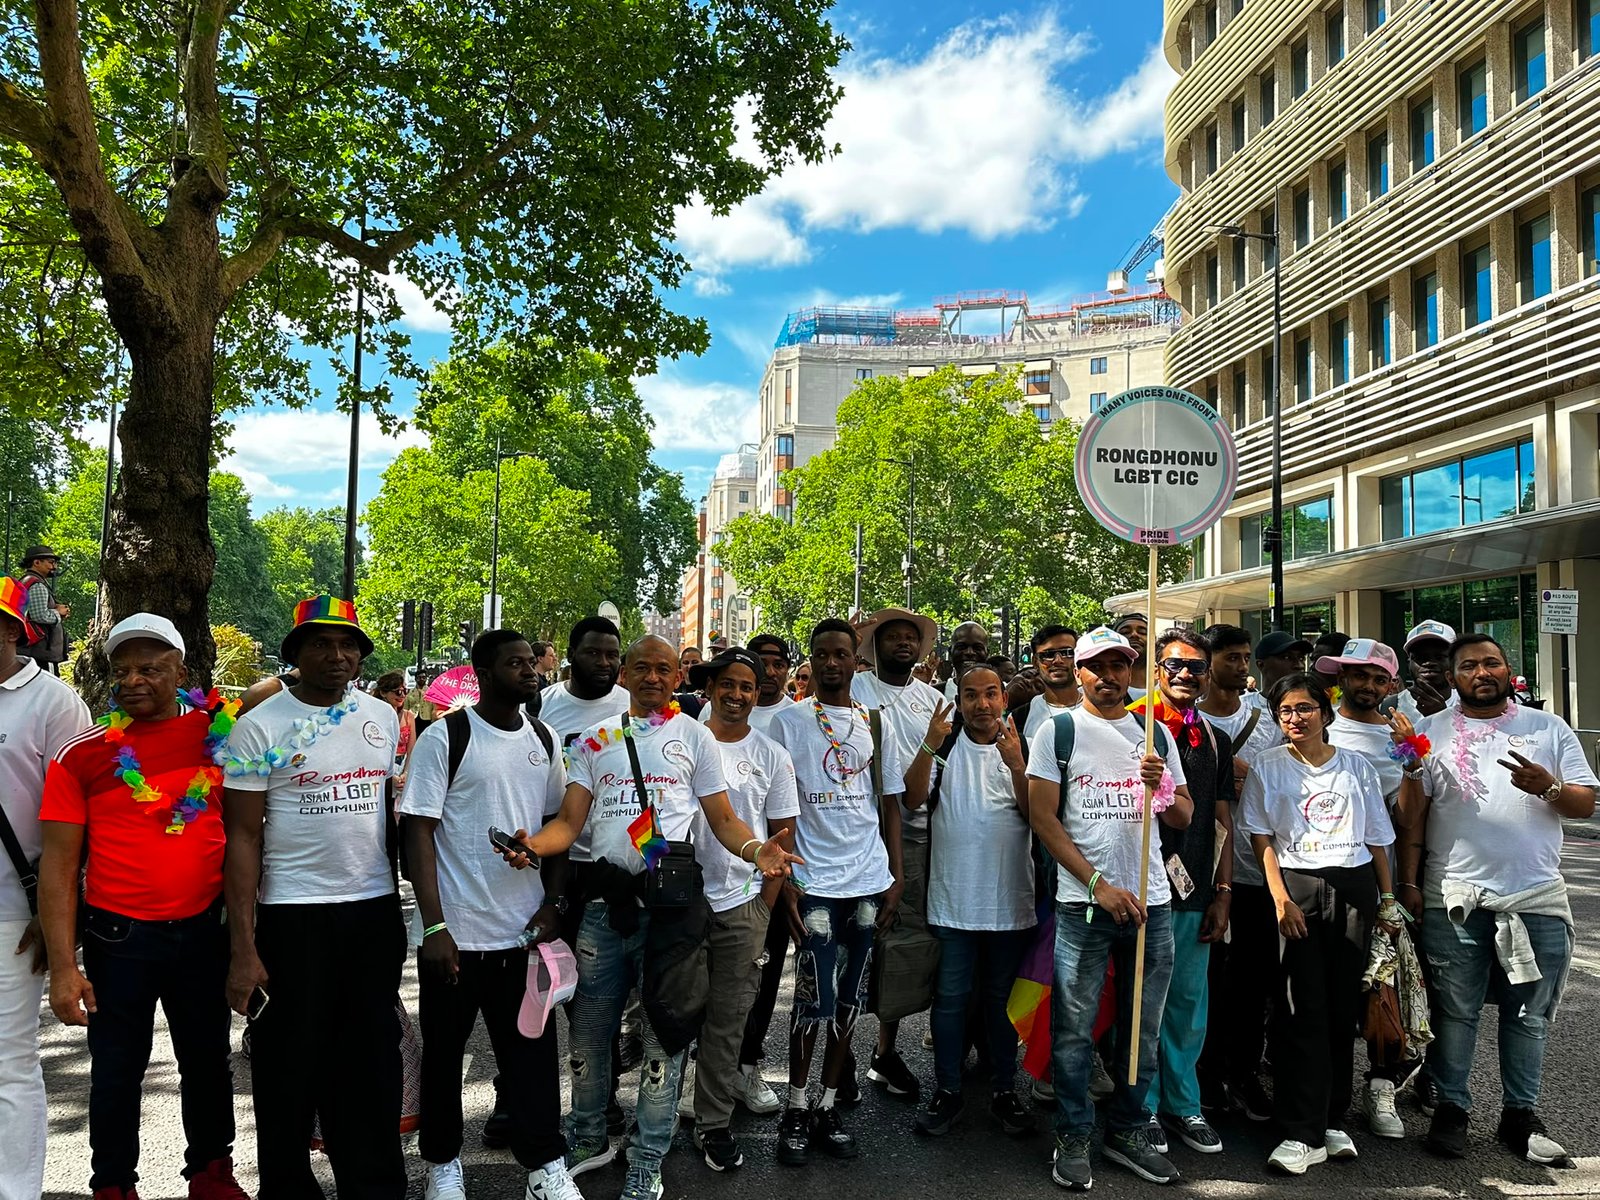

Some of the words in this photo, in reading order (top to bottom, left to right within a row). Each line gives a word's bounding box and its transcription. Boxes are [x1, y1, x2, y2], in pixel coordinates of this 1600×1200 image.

[1100, 395, 1126, 418] MANY
[1126, 388, 1164, 401] VOICES
[1165, 390, 1186, 402] ONE
[1186, 397, 1217, 421] FRONT
[1096, 447, 1218, 467] RONGDHONU
[1114, 468, 1162, 485] LGBT
[1166, 470, 1199, 486] CIC
[440, 676, 458, 688] THE
[460, 681, 480, 691] DRA
[462, 673, 479, 682] AM
[299, 791, 330, 804] ASIAN
[332, 782, 380, 801] LGBT
[803, 791, 835, 804] LGBT
[299, 801, 379, 815] COMMUNITY
[602, 796, 618, 807] ASIAN
[1082, 798, 1105, 809] ASIAN
[600, 808, 664, 819] COMMUNY
[1082, 811, 1143, 820] COMMUNIT
[1322, 841, 1364, 850] COMMUN
